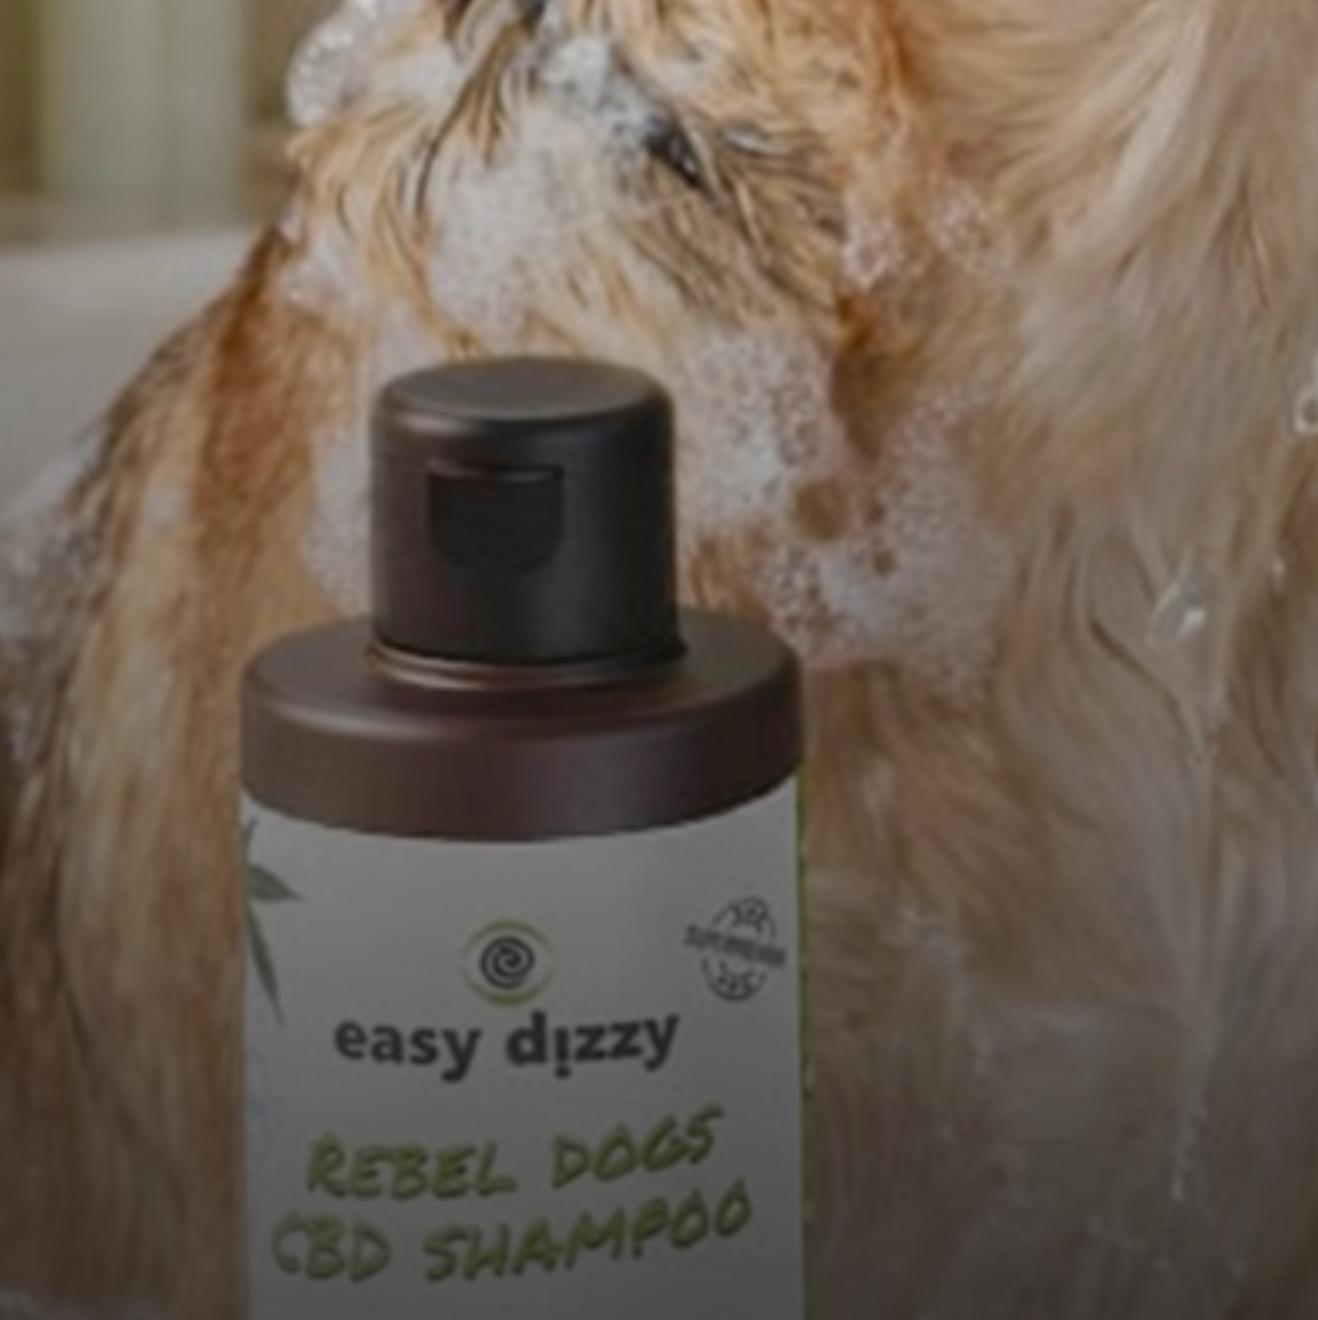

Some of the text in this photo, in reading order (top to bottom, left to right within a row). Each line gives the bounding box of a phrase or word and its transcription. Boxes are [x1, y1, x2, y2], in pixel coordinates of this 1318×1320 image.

[333, 1020, 482, 1082] easy
[307, 1103, 724, 1200] REBEL DOGS
[271, 1179, 753, 1282] CBD SHAMPOO
